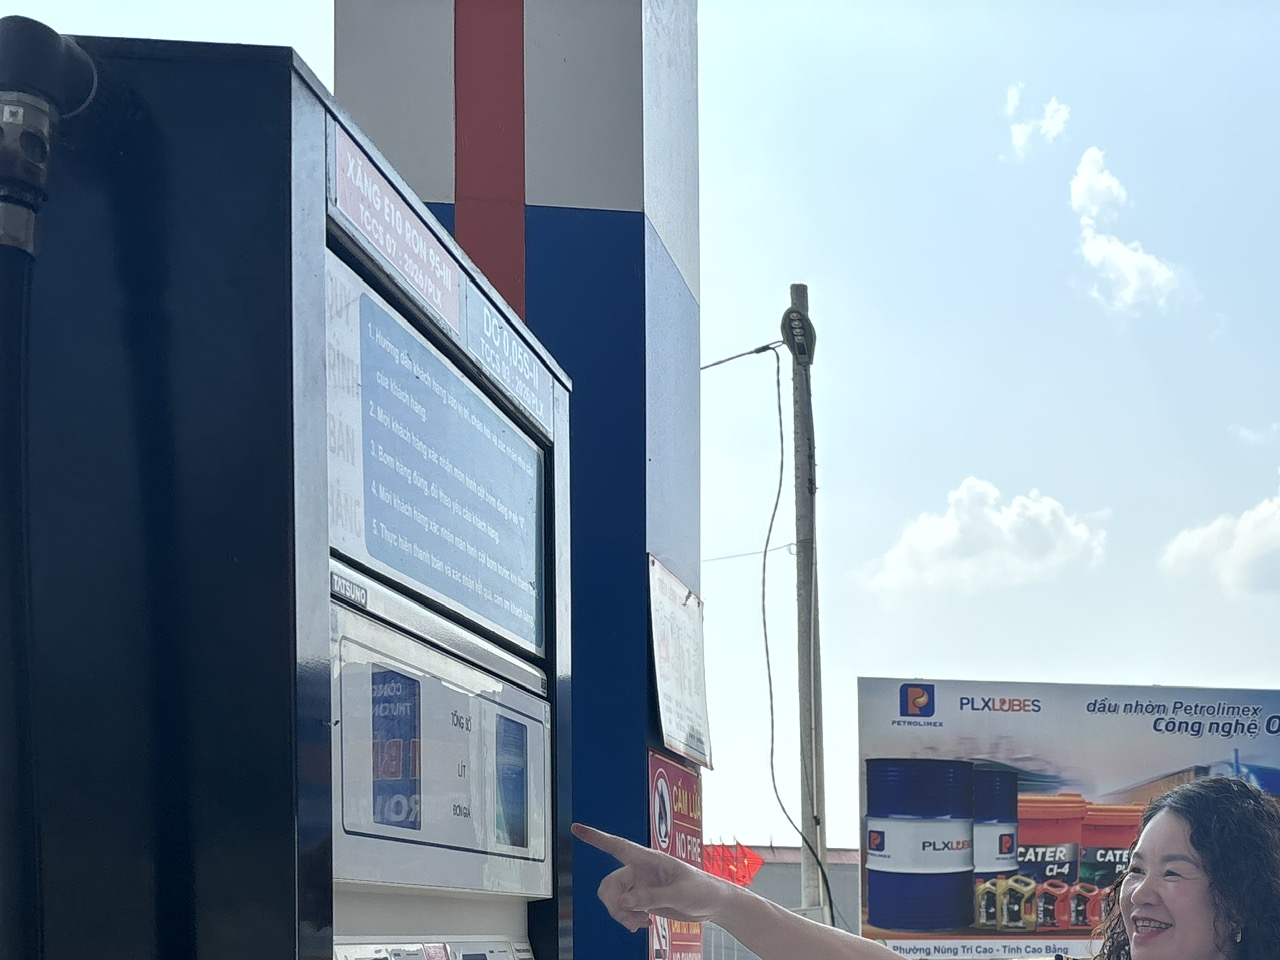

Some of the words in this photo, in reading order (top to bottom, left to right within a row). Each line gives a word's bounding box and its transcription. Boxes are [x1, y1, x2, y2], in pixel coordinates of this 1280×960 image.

[346, 152, 382, 211] XĂNG
[384, 200, 402, 235] E10
[405, 221, 427, 263] RON
[360, 204, 384, 248] TCCS
[333, 575, 366, 604] TATSUNO
[960, 697, 1042, 713] PLXLUBES
[1086, 696, 1118, 714] dầu
[1124, 699, 1168, 715] nhờn
[1172, 700, 1262, 718] Petrolimex
[892, 720, 944, 728] PETROLIMEX
[1153, 716, 1203, 736] Công
[1208, 716, 1259, 738] nghệ
[458, 761, 466, 778] LÍT
[672, 778, 688, 816] CẤM
[689, 784, 701, 821] LỬA
[676, 831, 686, 859] NO
[687, 835, 702, 863] FIRE
[1018, 847, 1067, 862] CATER
[1096, 849, 1129, 862] CATE
[1046, 863, 1070, 876] CI-4
[893, 944, 931, 956] Phường
[934, 945, 958, 956] Nùng
[961, 945, 974, 954] Trí
[976, 946, 994, 954] Cao
[1002, 945, 1022, 954] Tỉnh
[1024, 946, 1042, 954] Cao
[1045, 943, 1068, 956] Bằng
